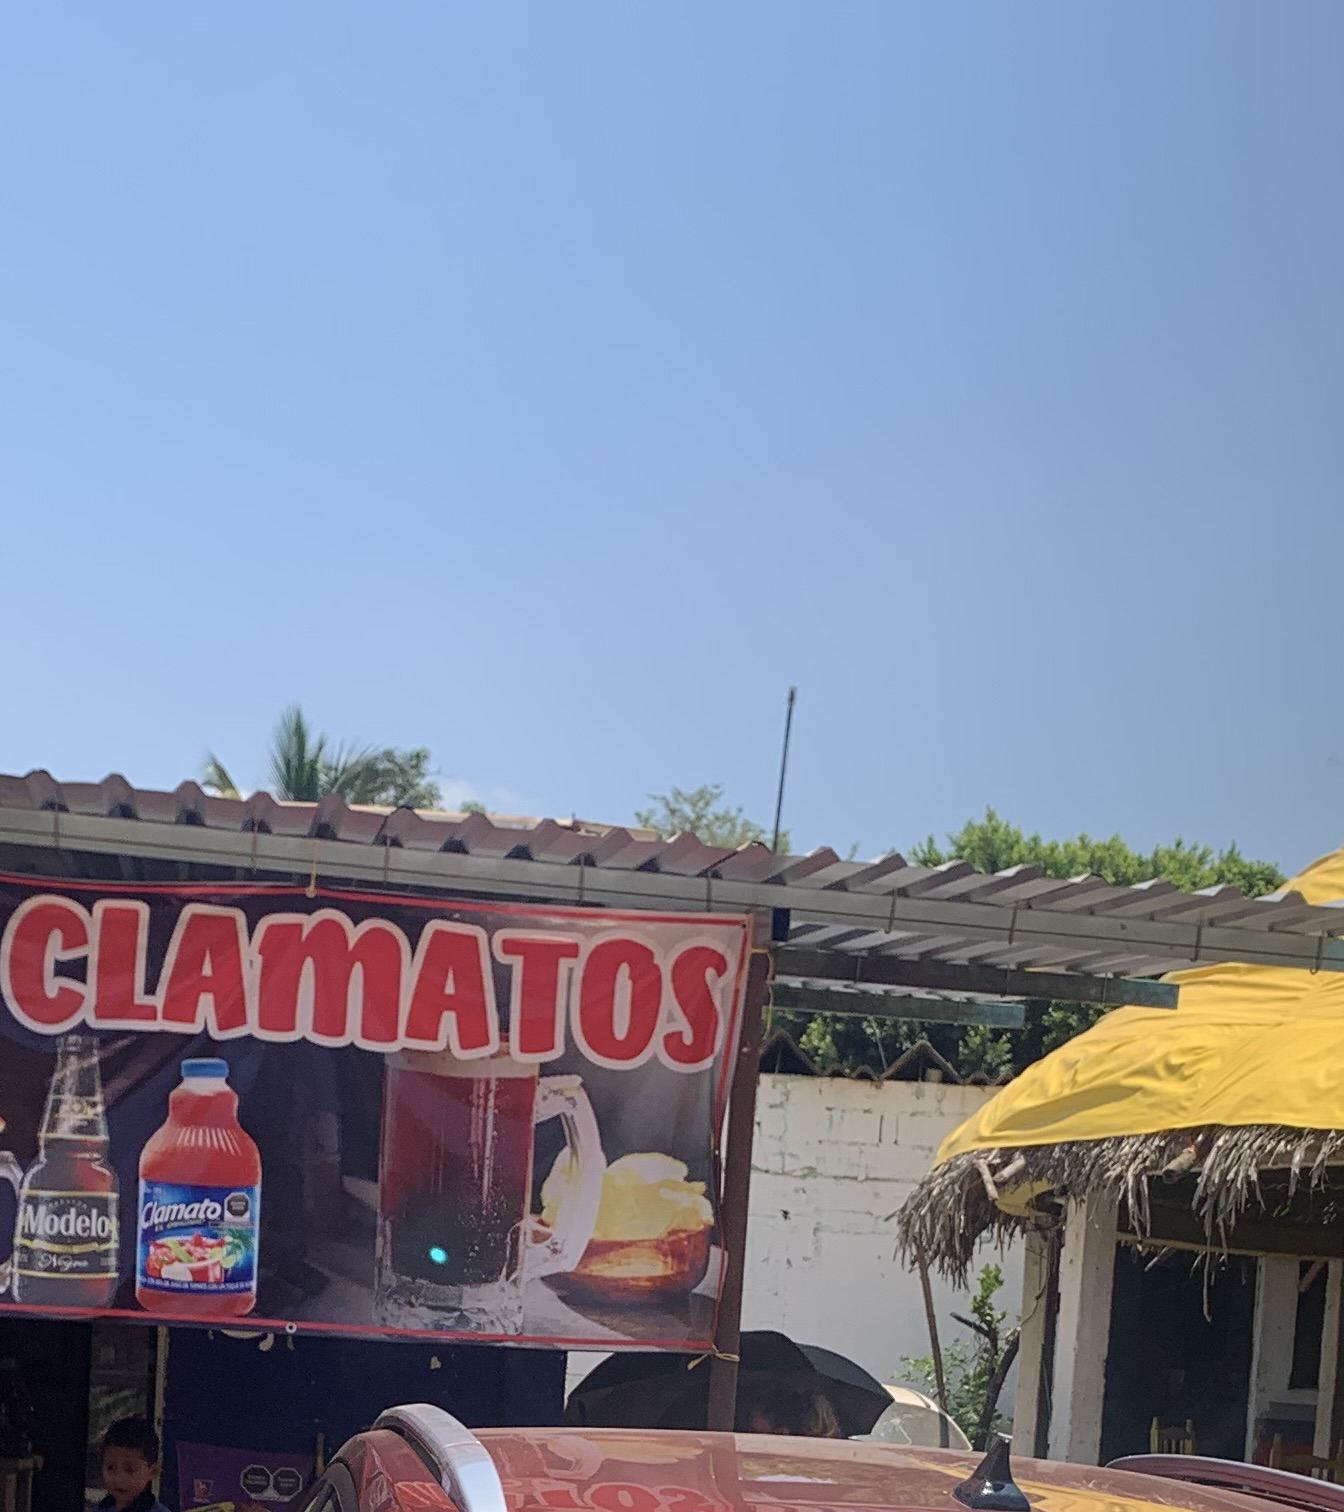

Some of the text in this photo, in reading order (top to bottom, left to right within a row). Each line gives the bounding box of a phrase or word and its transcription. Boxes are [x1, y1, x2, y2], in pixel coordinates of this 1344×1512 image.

[0, 895, 730, 1072] CLAMATOS
[23, 1203, 112, 1239] Modelo
[141, 1197, 222, 1229] Clamato
